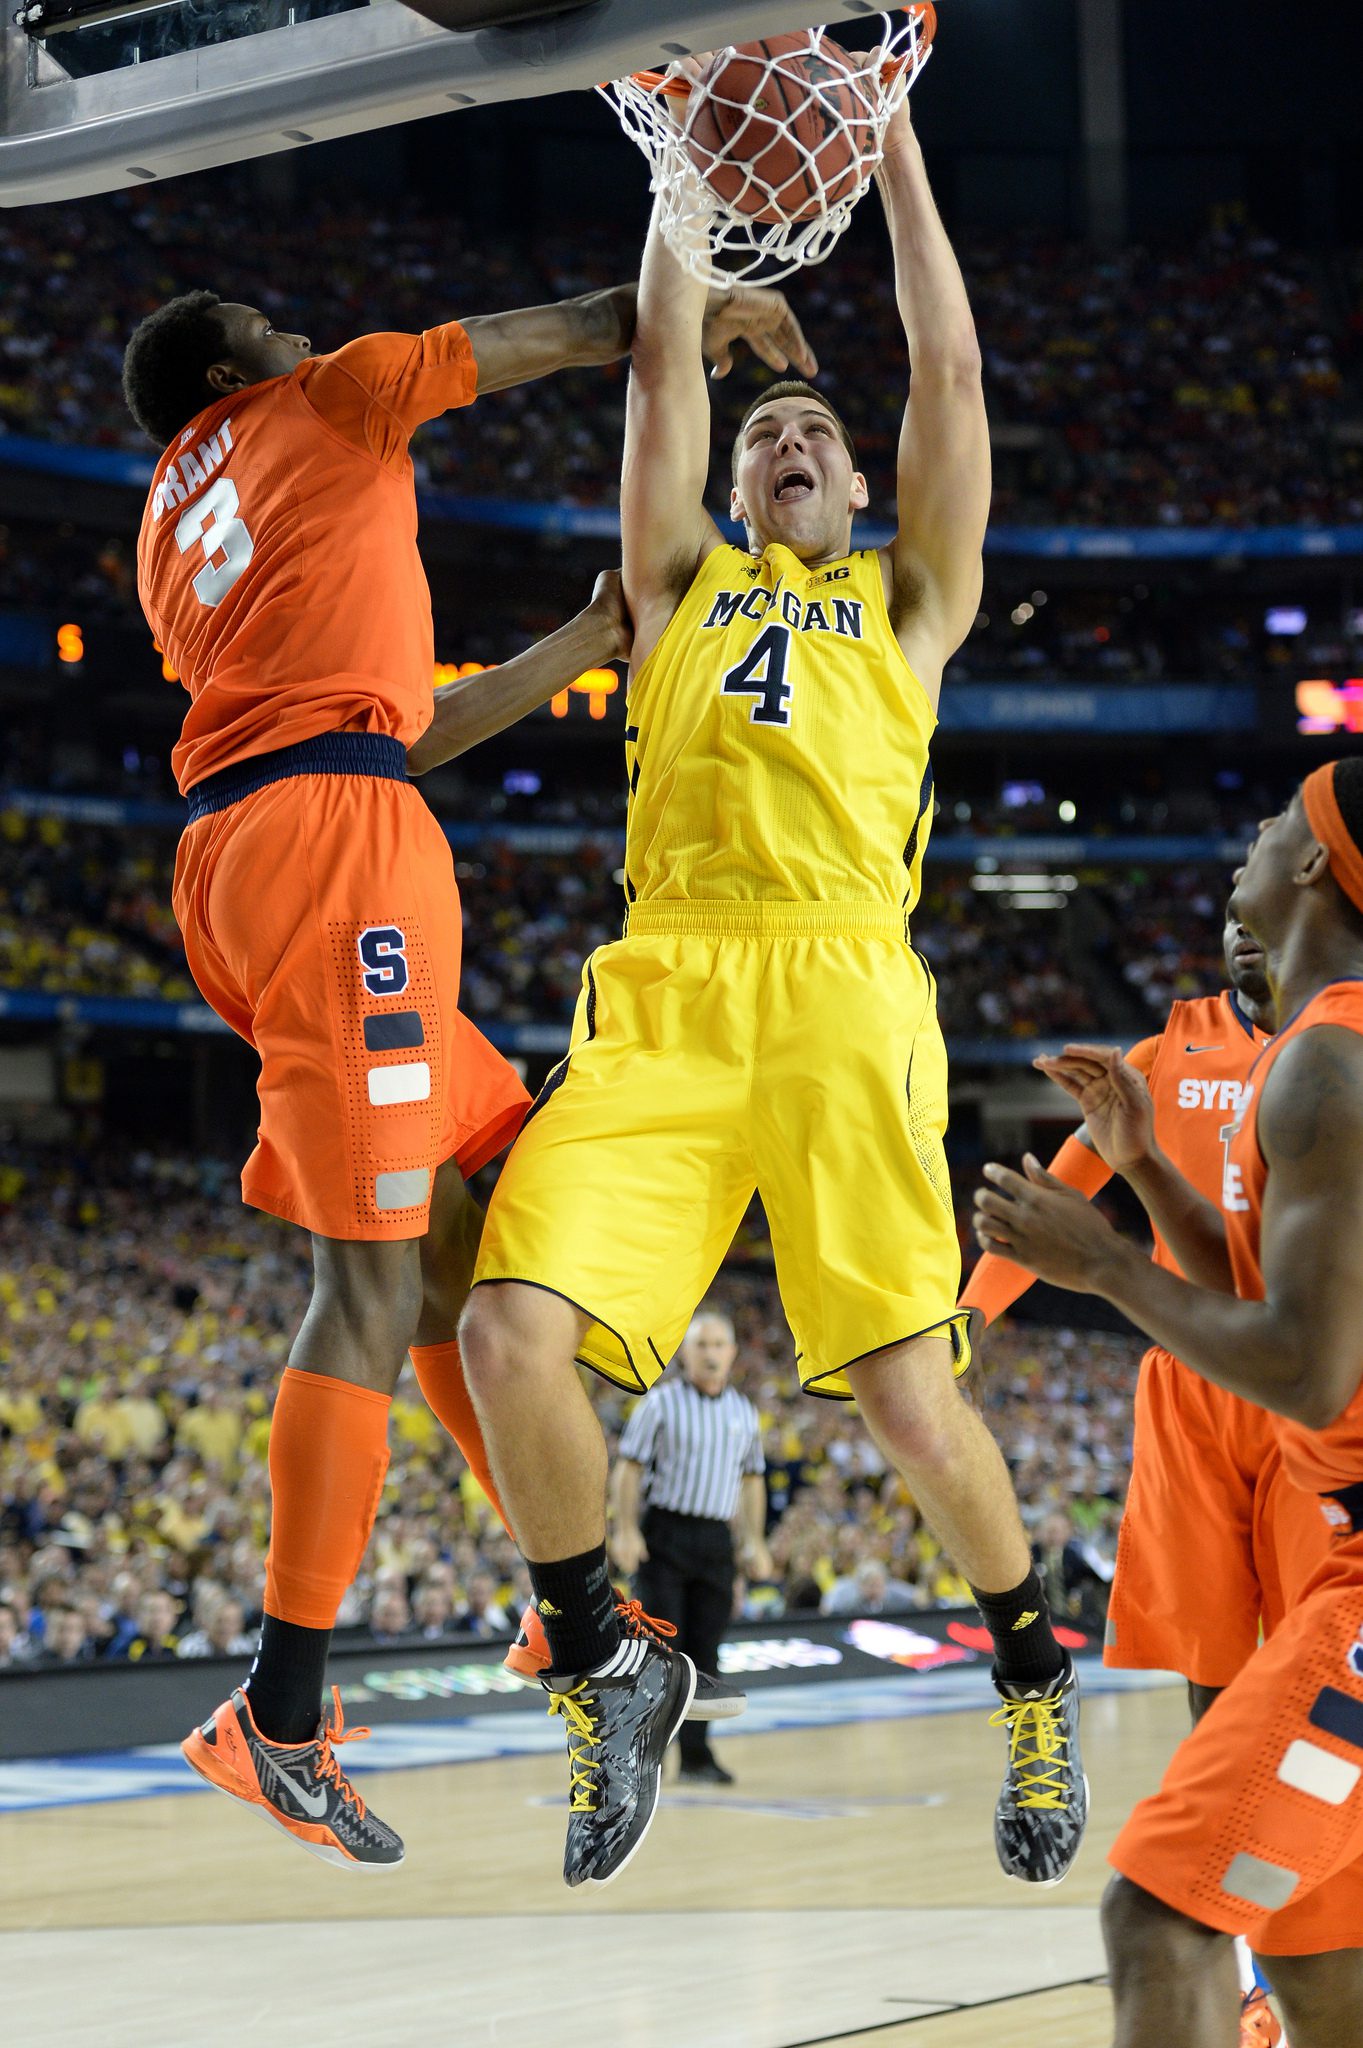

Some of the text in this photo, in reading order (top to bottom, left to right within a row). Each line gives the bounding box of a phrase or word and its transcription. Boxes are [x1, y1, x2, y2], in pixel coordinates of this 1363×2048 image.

[153, 417, 234, 522] GRANT
[175, 477, 254, 607] 3
[702, 576, 863, 639] MCGAN
[721, 623, 792, 728] 4
[357, 925, 409, 997] S
